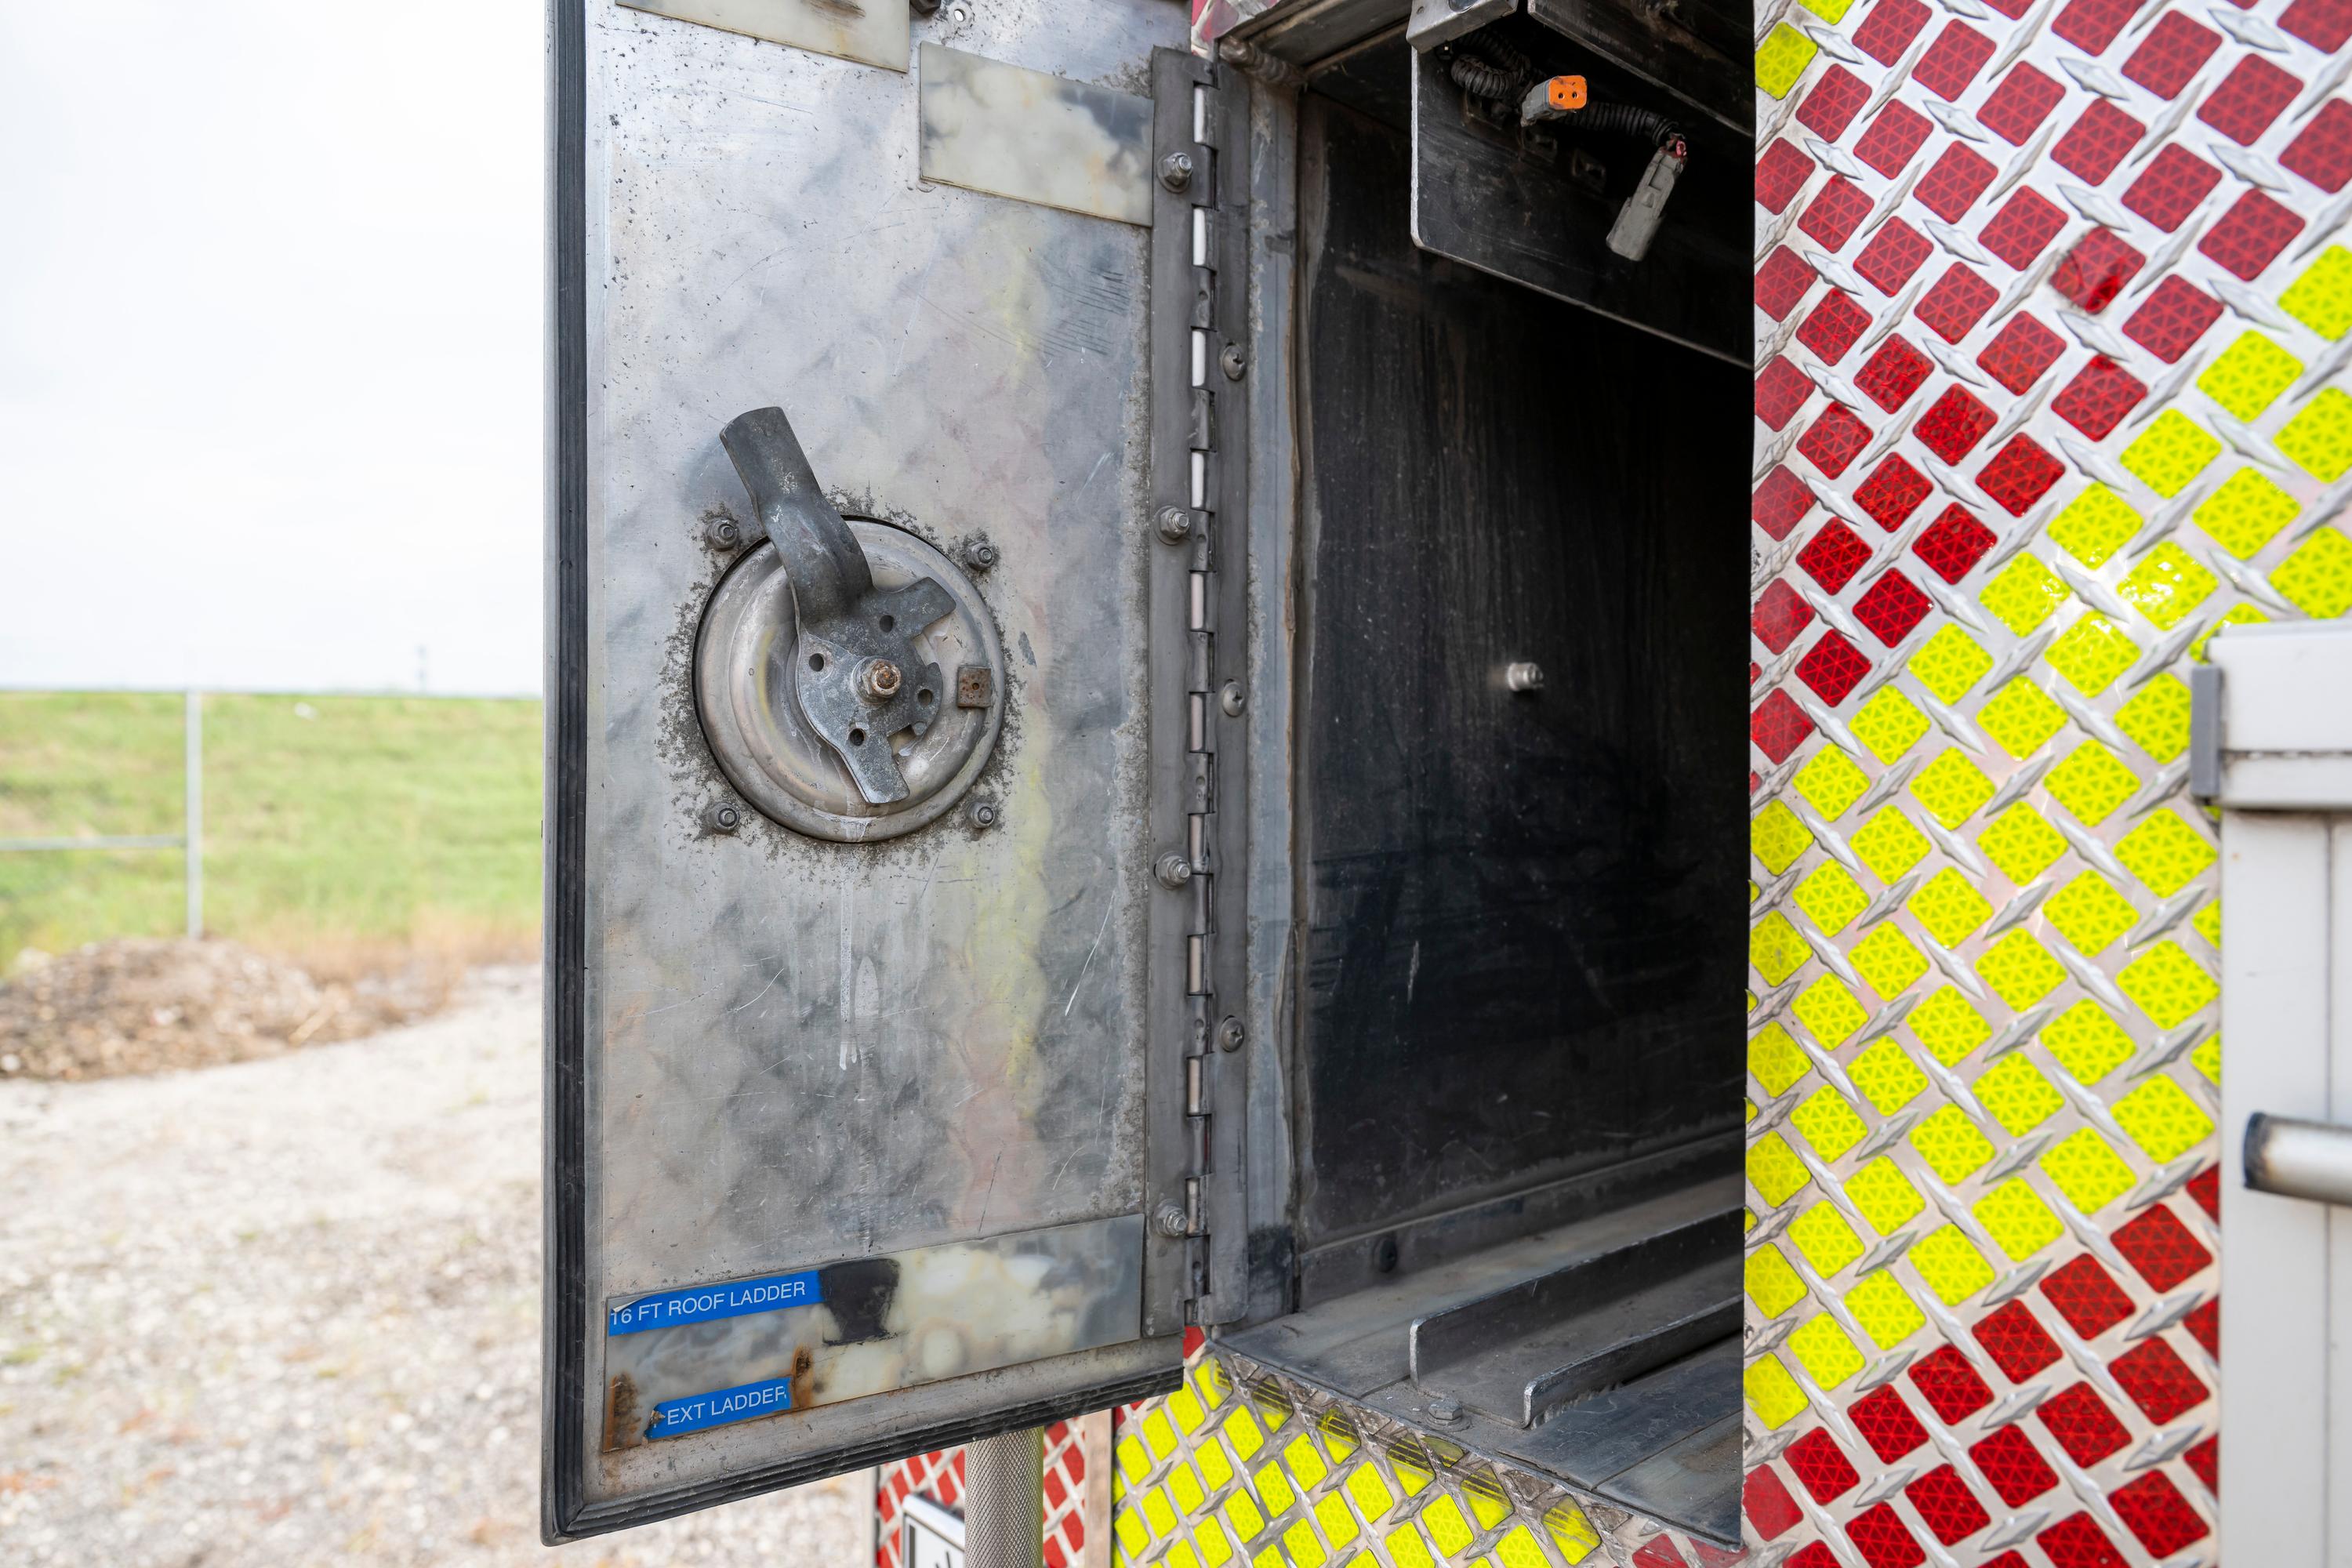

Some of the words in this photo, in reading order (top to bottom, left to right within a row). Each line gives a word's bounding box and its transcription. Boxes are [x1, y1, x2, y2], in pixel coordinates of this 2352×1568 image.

[611, 1308, 632, 1325] 16
[638, 1303, 662, 1321] FT
[668, 1294, 725, 1316] ROOF
[730, 1281, 806, 1307] LADDER
[667, 1403, 706, 1425] EXT
